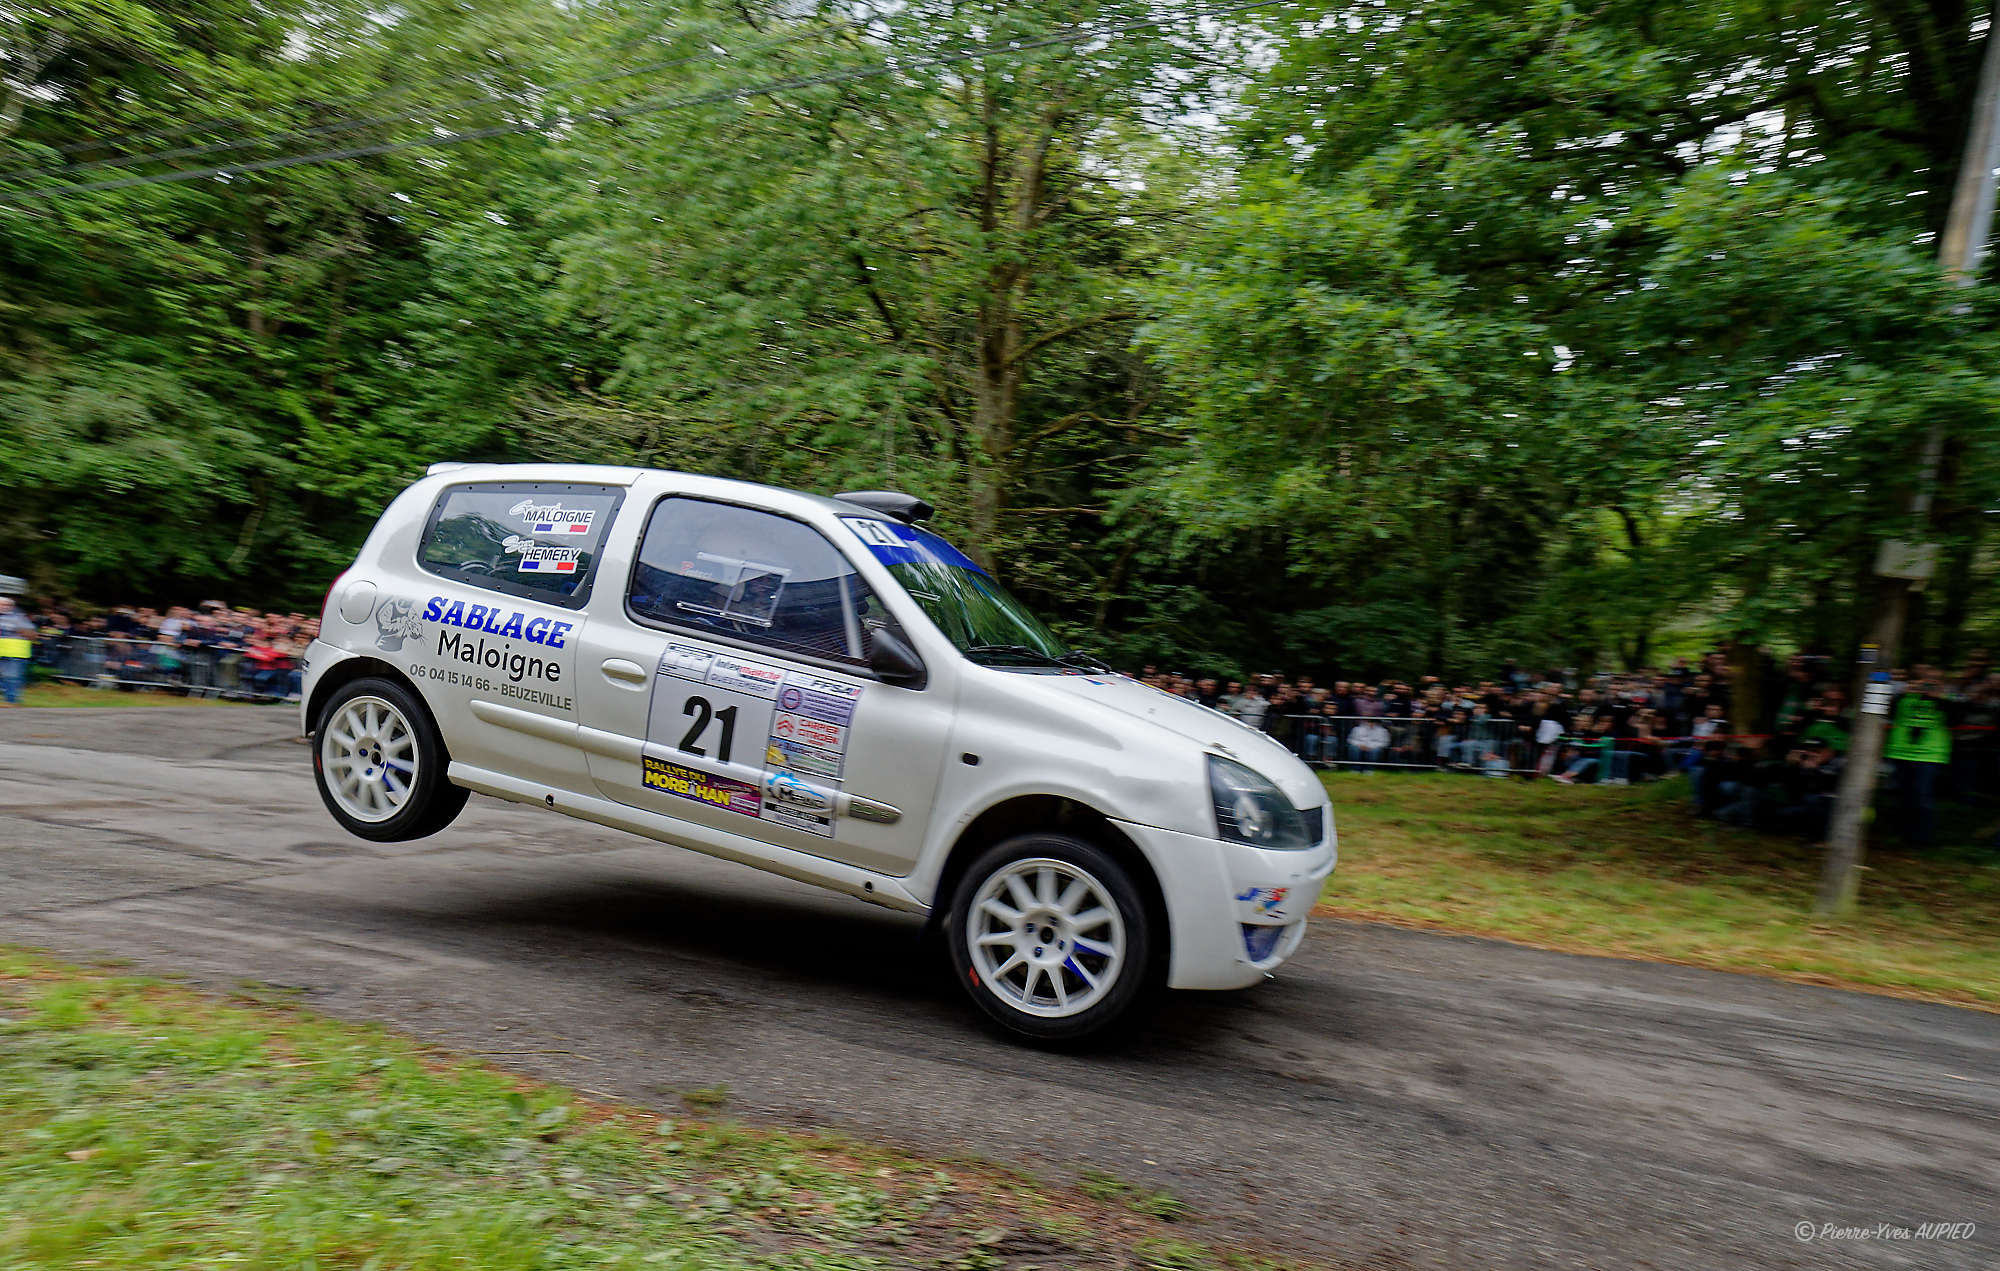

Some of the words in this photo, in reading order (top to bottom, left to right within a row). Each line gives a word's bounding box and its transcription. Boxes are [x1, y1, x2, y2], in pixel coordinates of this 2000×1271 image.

[525, 511, 593, 523] MALOIGNE
[524, 548, 580, 561] HEMERY
[422, 596, 574, 649] SABLAGE
[437, 629, 561, 683] Maloigne
[409, 663, 426, 677] 06
[429, 667, 445, 682] 04
[448, 671, 459, 685] 15
[461, 674, 473, 688] 14
[475, 677, 490, 692] 66
[501, 683, 572, 711] BEUZEVILLE
[677, 695, 739, 764] 21
[644, 759, 690, 779] RALLYE
